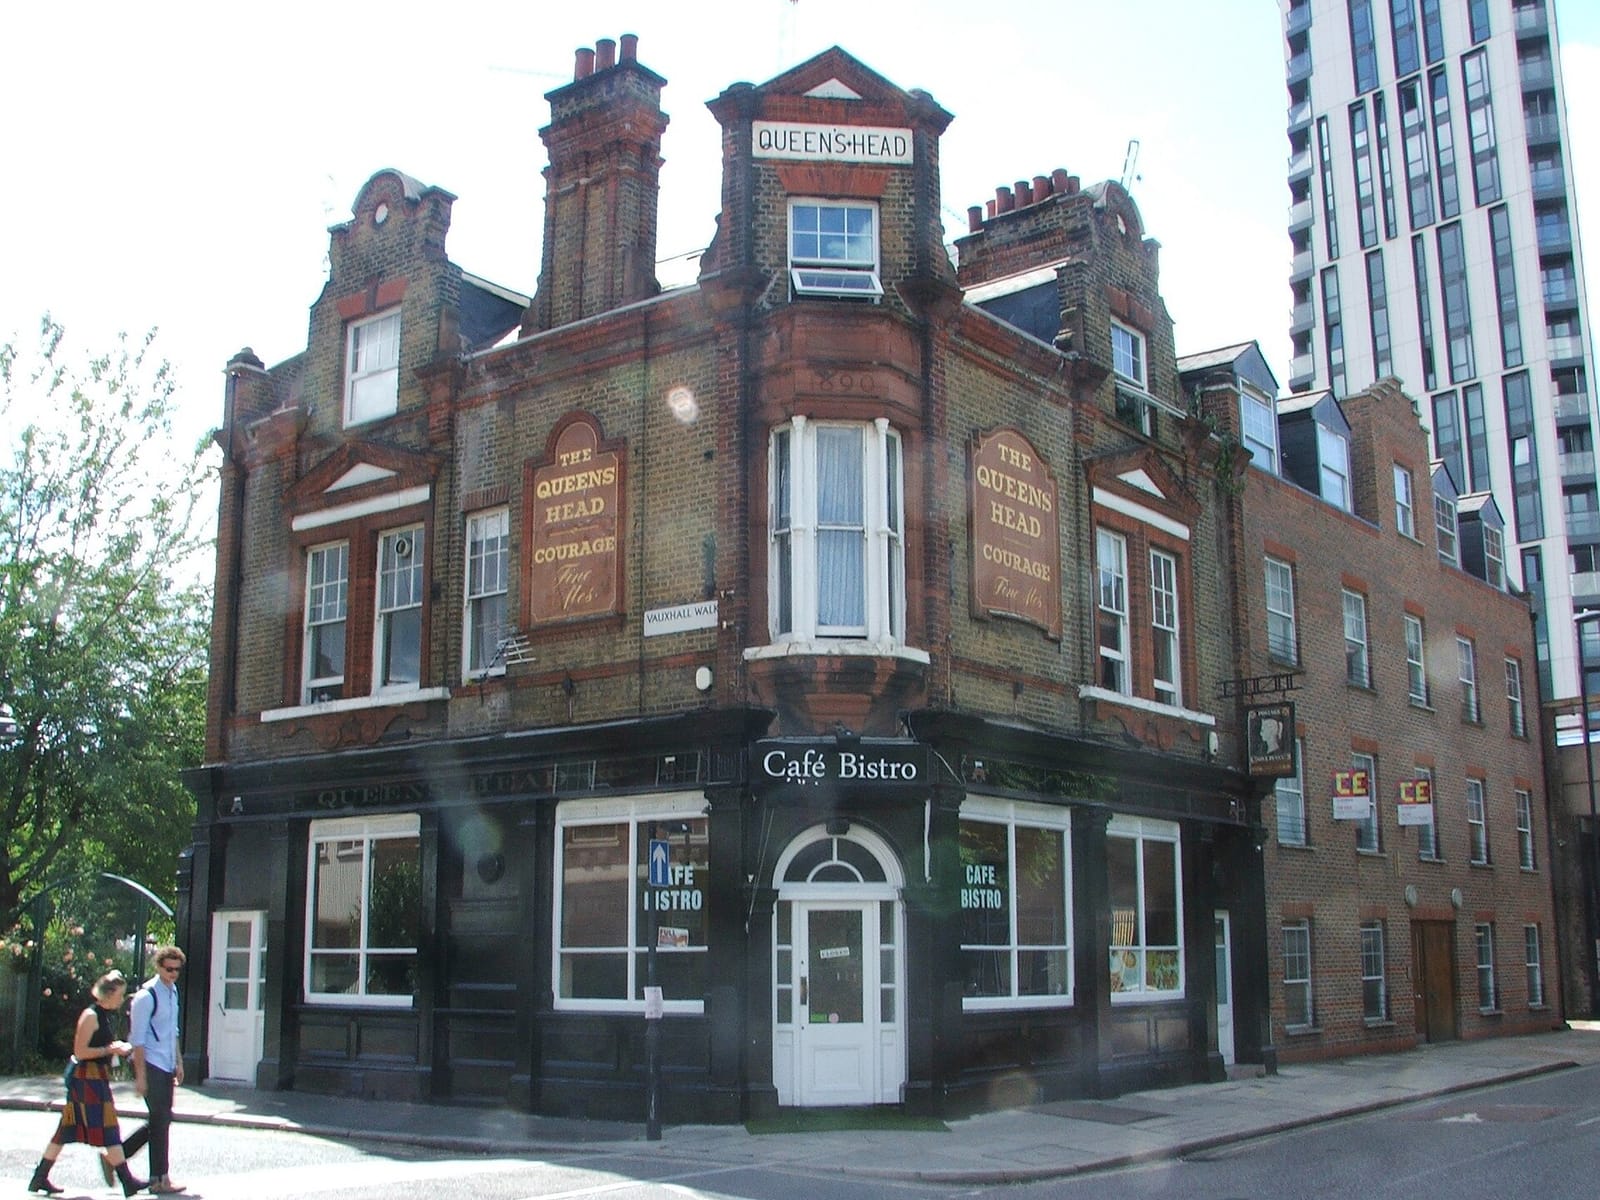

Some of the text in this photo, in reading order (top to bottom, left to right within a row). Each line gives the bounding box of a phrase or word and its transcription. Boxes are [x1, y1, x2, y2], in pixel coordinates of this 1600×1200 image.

[853, 134, 906, 157] HEAD
[560, 448, 591, 467] THE
[998, 443, 1031, 472] THE
[537, 467, 615, 499] QUEENS
[977, 465, 1052, 512] QUEENS
[545, 497, 604, 524] HEAD
[990, 501, 1041, 538] HEAD
[534, 537, 615, 564] COURAGE
[983, 544, 1050, 581] COURAGE
[647, 608, 691, 623] VAUXHALL
[763, 750, 917, 780] Café Bistro
[966, 865, 995, 885] CAFE
[961, 889, 1001, 909] BISTRO
